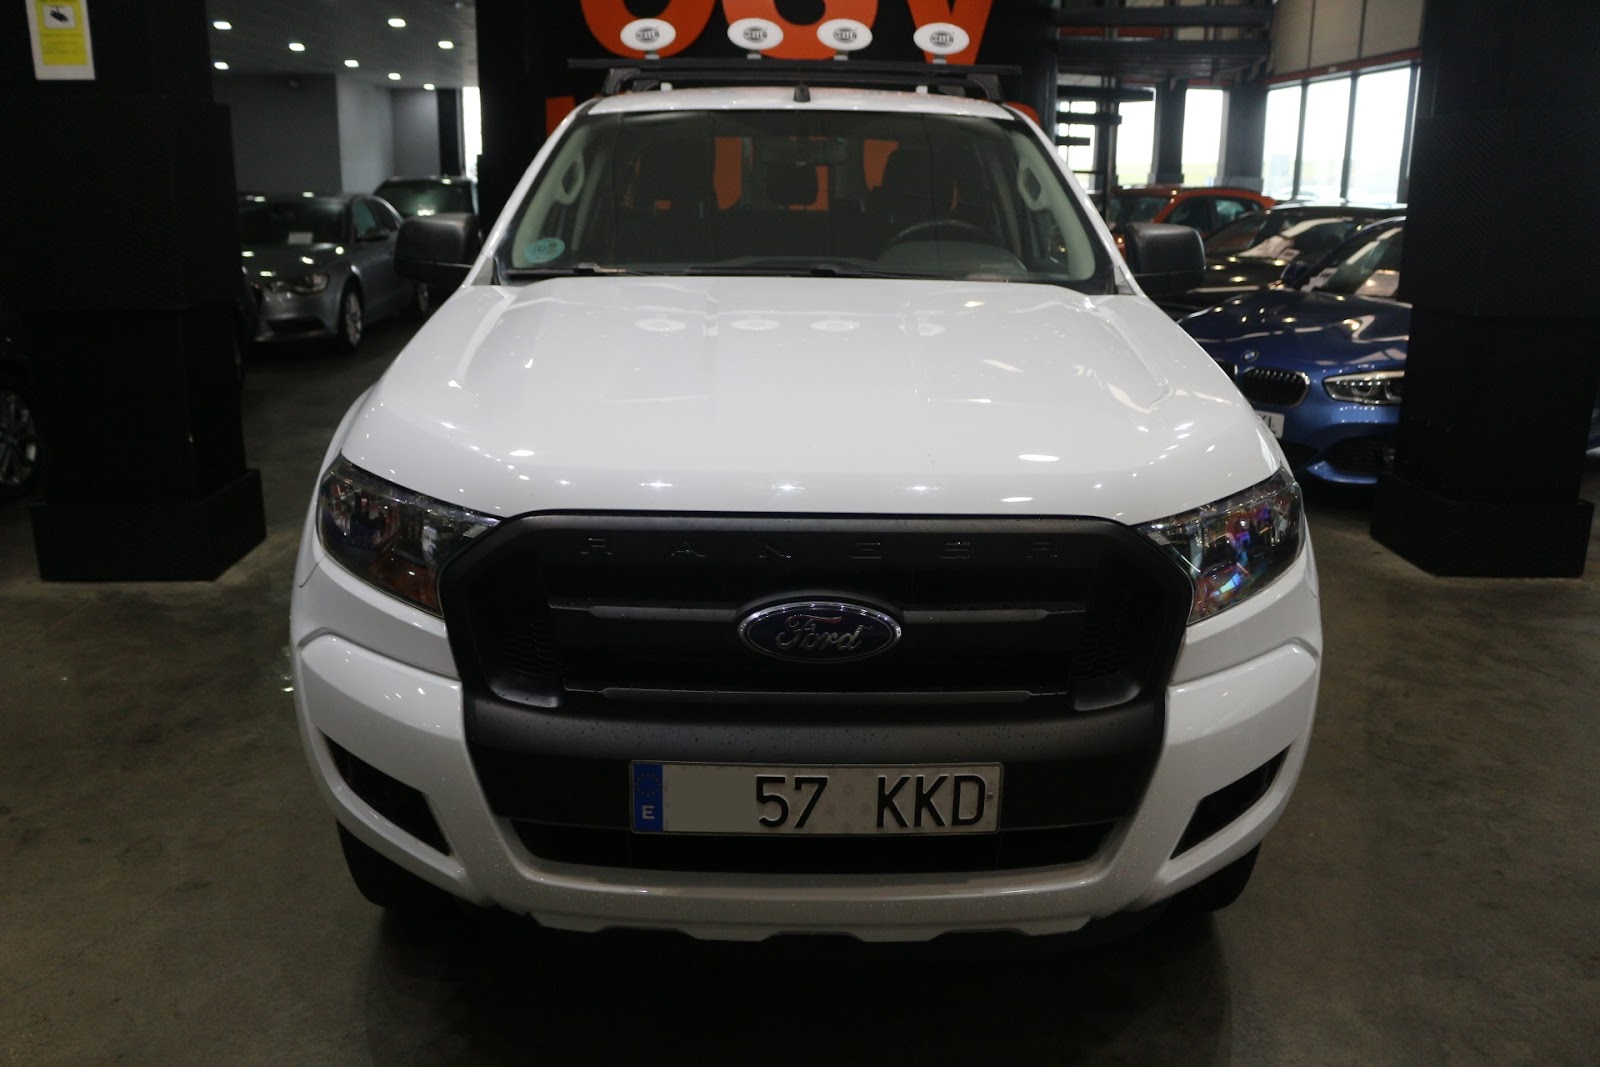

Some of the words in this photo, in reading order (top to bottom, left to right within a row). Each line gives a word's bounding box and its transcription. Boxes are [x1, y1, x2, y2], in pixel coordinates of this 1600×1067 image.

[775, 613, 863, 651] Ford
[642, 805, 655, 820] E
[755, 775, 829, 828] 57
[875, 774, 987, 828] KKD
